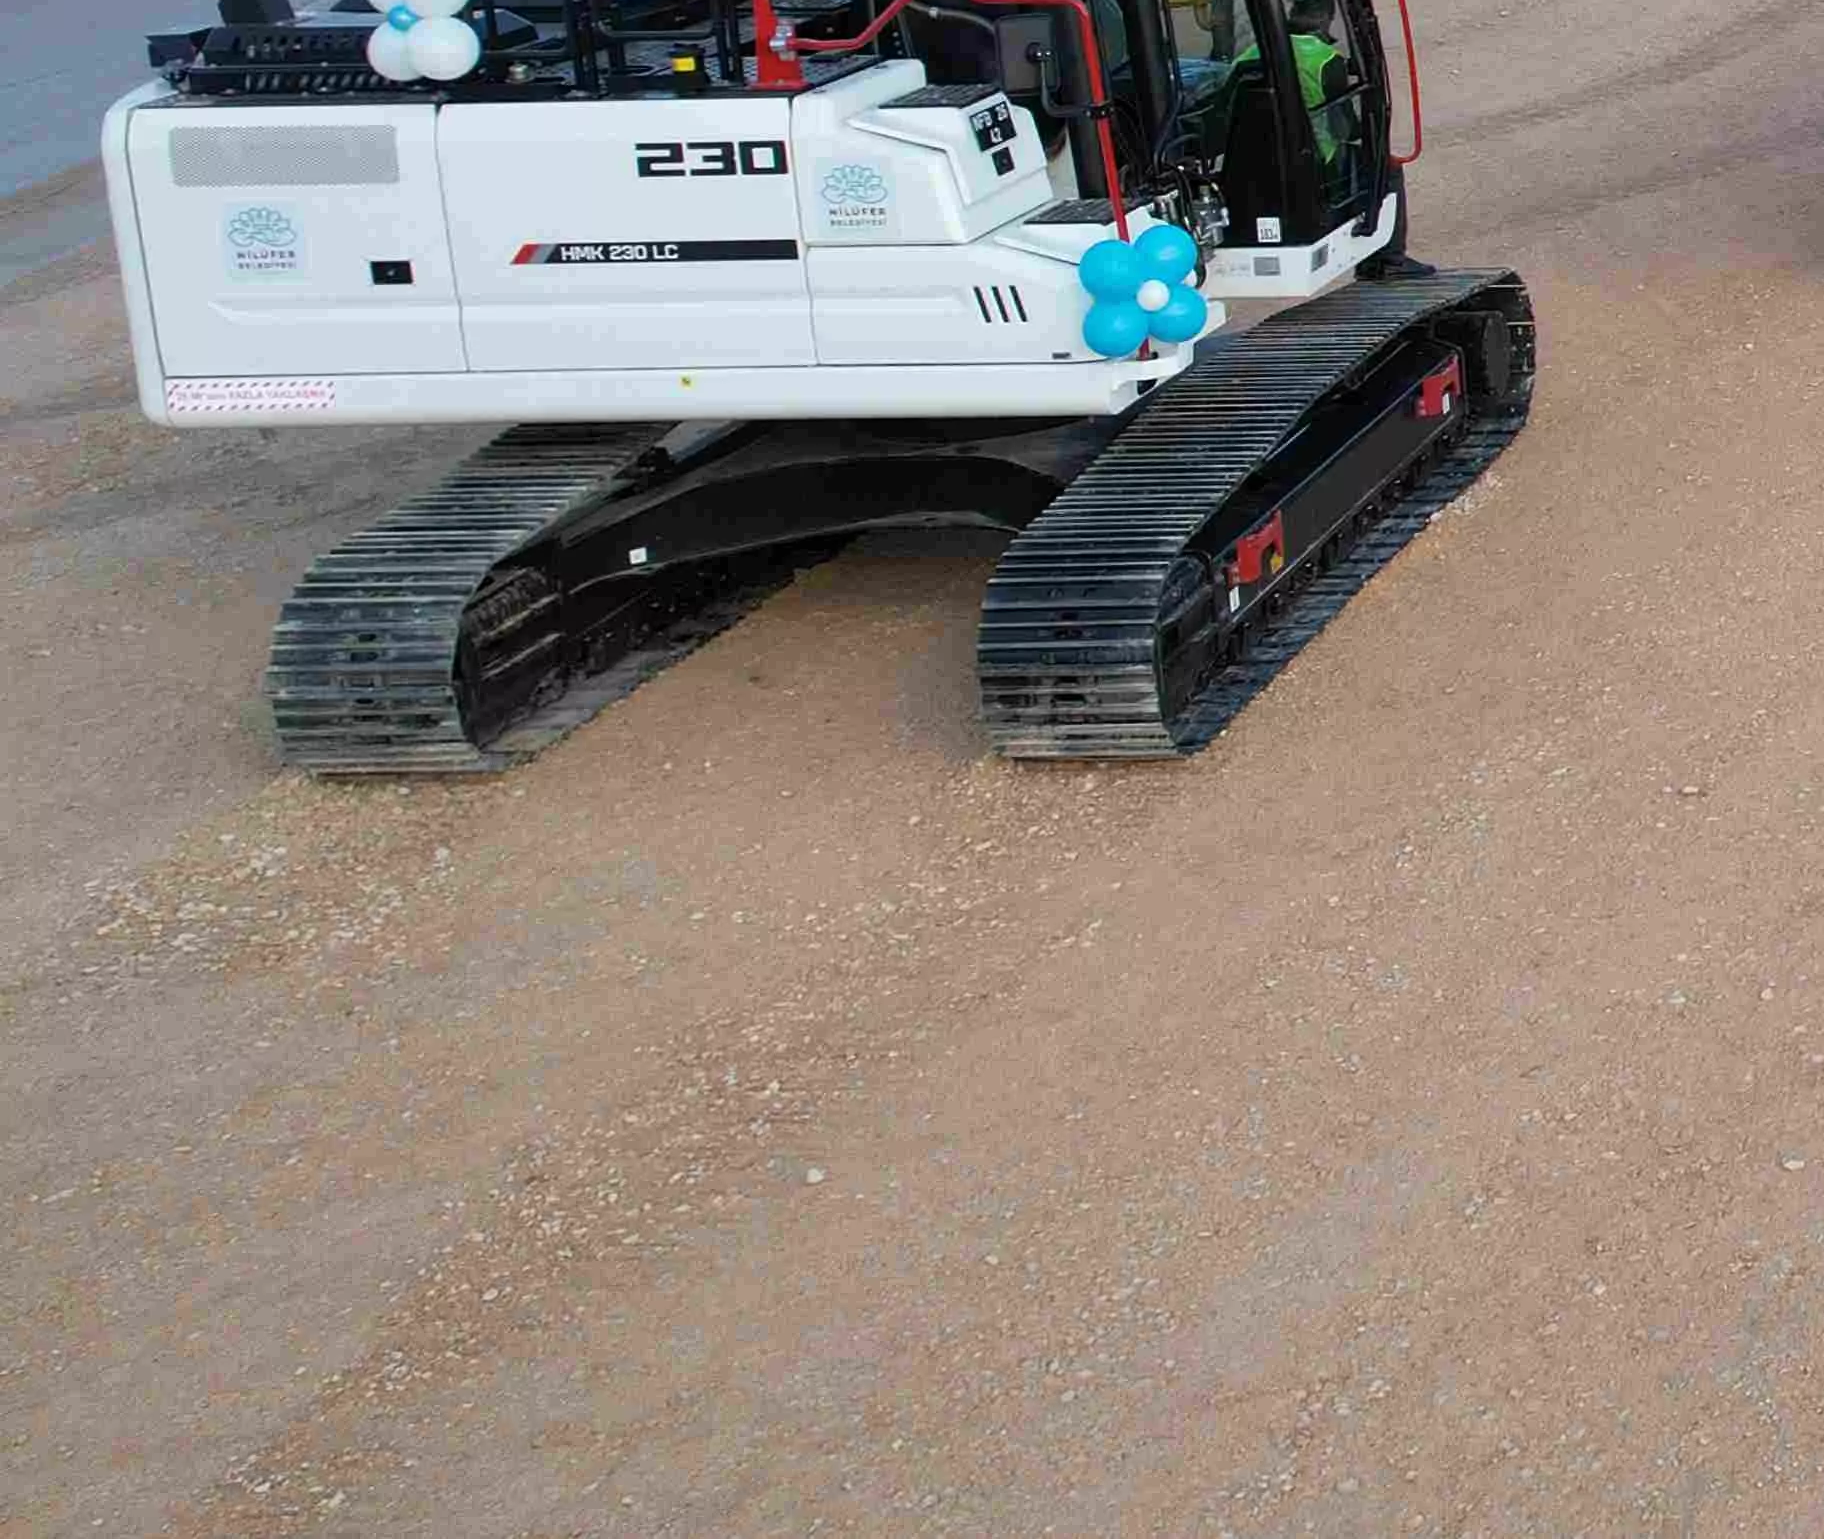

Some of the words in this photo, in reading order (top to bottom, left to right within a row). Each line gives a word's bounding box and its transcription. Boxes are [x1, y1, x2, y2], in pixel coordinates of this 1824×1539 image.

[635, 140, 789, 177] 230
[561, 245, 604, 261] HMK
[609, 245, 648, 260] 230
[653, 244, 679, 260] LC
